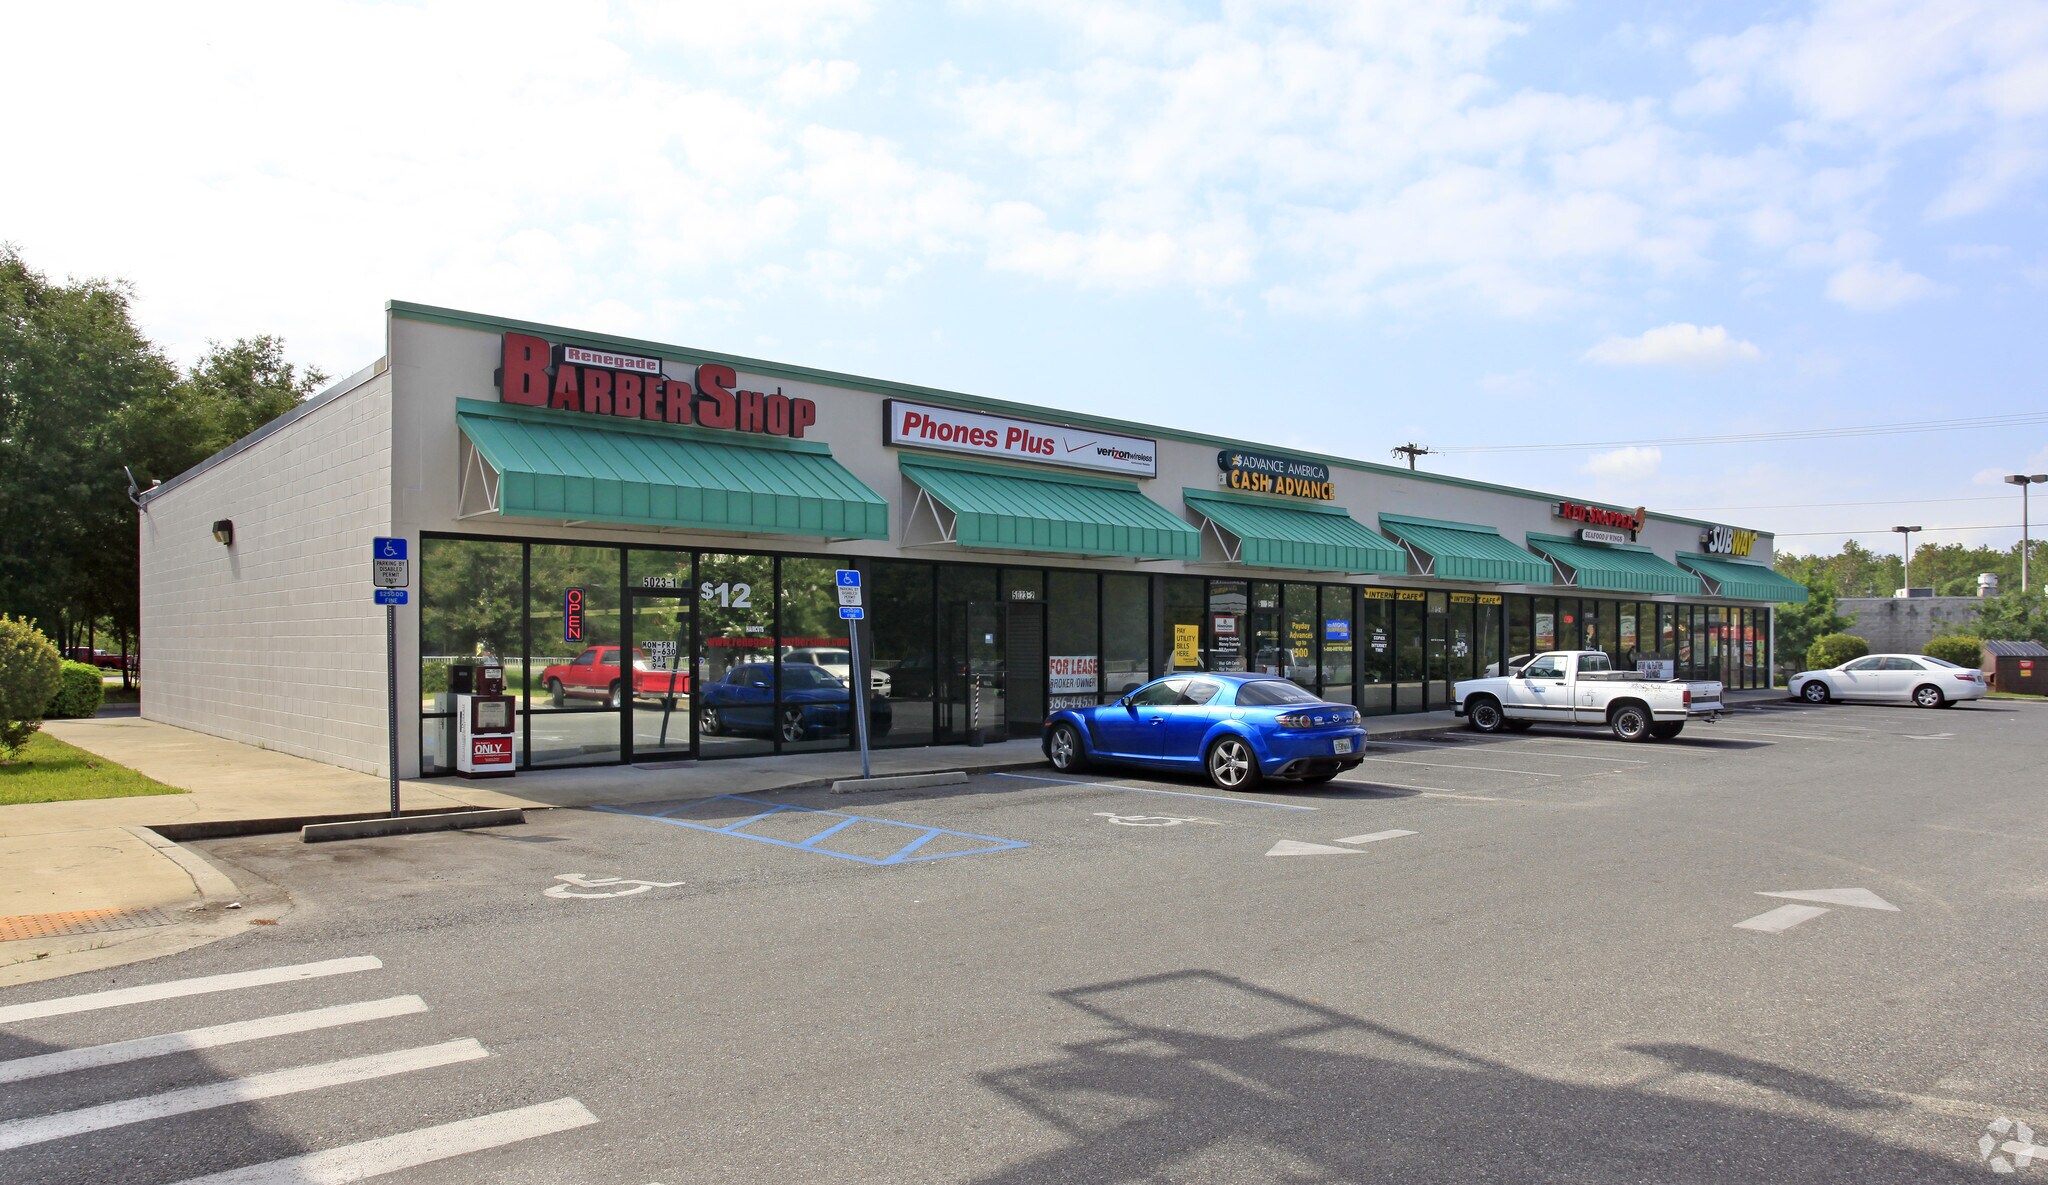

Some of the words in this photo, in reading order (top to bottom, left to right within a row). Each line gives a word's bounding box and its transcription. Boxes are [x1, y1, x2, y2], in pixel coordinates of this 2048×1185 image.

[568, 348, 657, 371] Renegade
[901, 411, 998, 449] Phones
[1005, 420, 1055, 456] Plus
[1243, 456, 1284, 473] ADVANCE
[1288, 464, 1325, 479] AMERICA
[1231, 469, 1269, 492] CASH
[1276, 476, 1335, 500] ADVANCE
[1562, 501, 1587, 522] RED
[1589, 506, 1634, 529] SNAPPER
[1585, 532, 1605, 540] SEAFOOD
[1710, 526, 1758, 556] SUBWAY
[643, 577, 677, 588] 5023-1
[700, 581, 752, 608] $12
[568, 590, 582, 639] OPEN
[1292, 622, 1310, 631] Payday
[1049, 659, 1069, 675] FOR
[475, 744, 502, 755] ONLY
